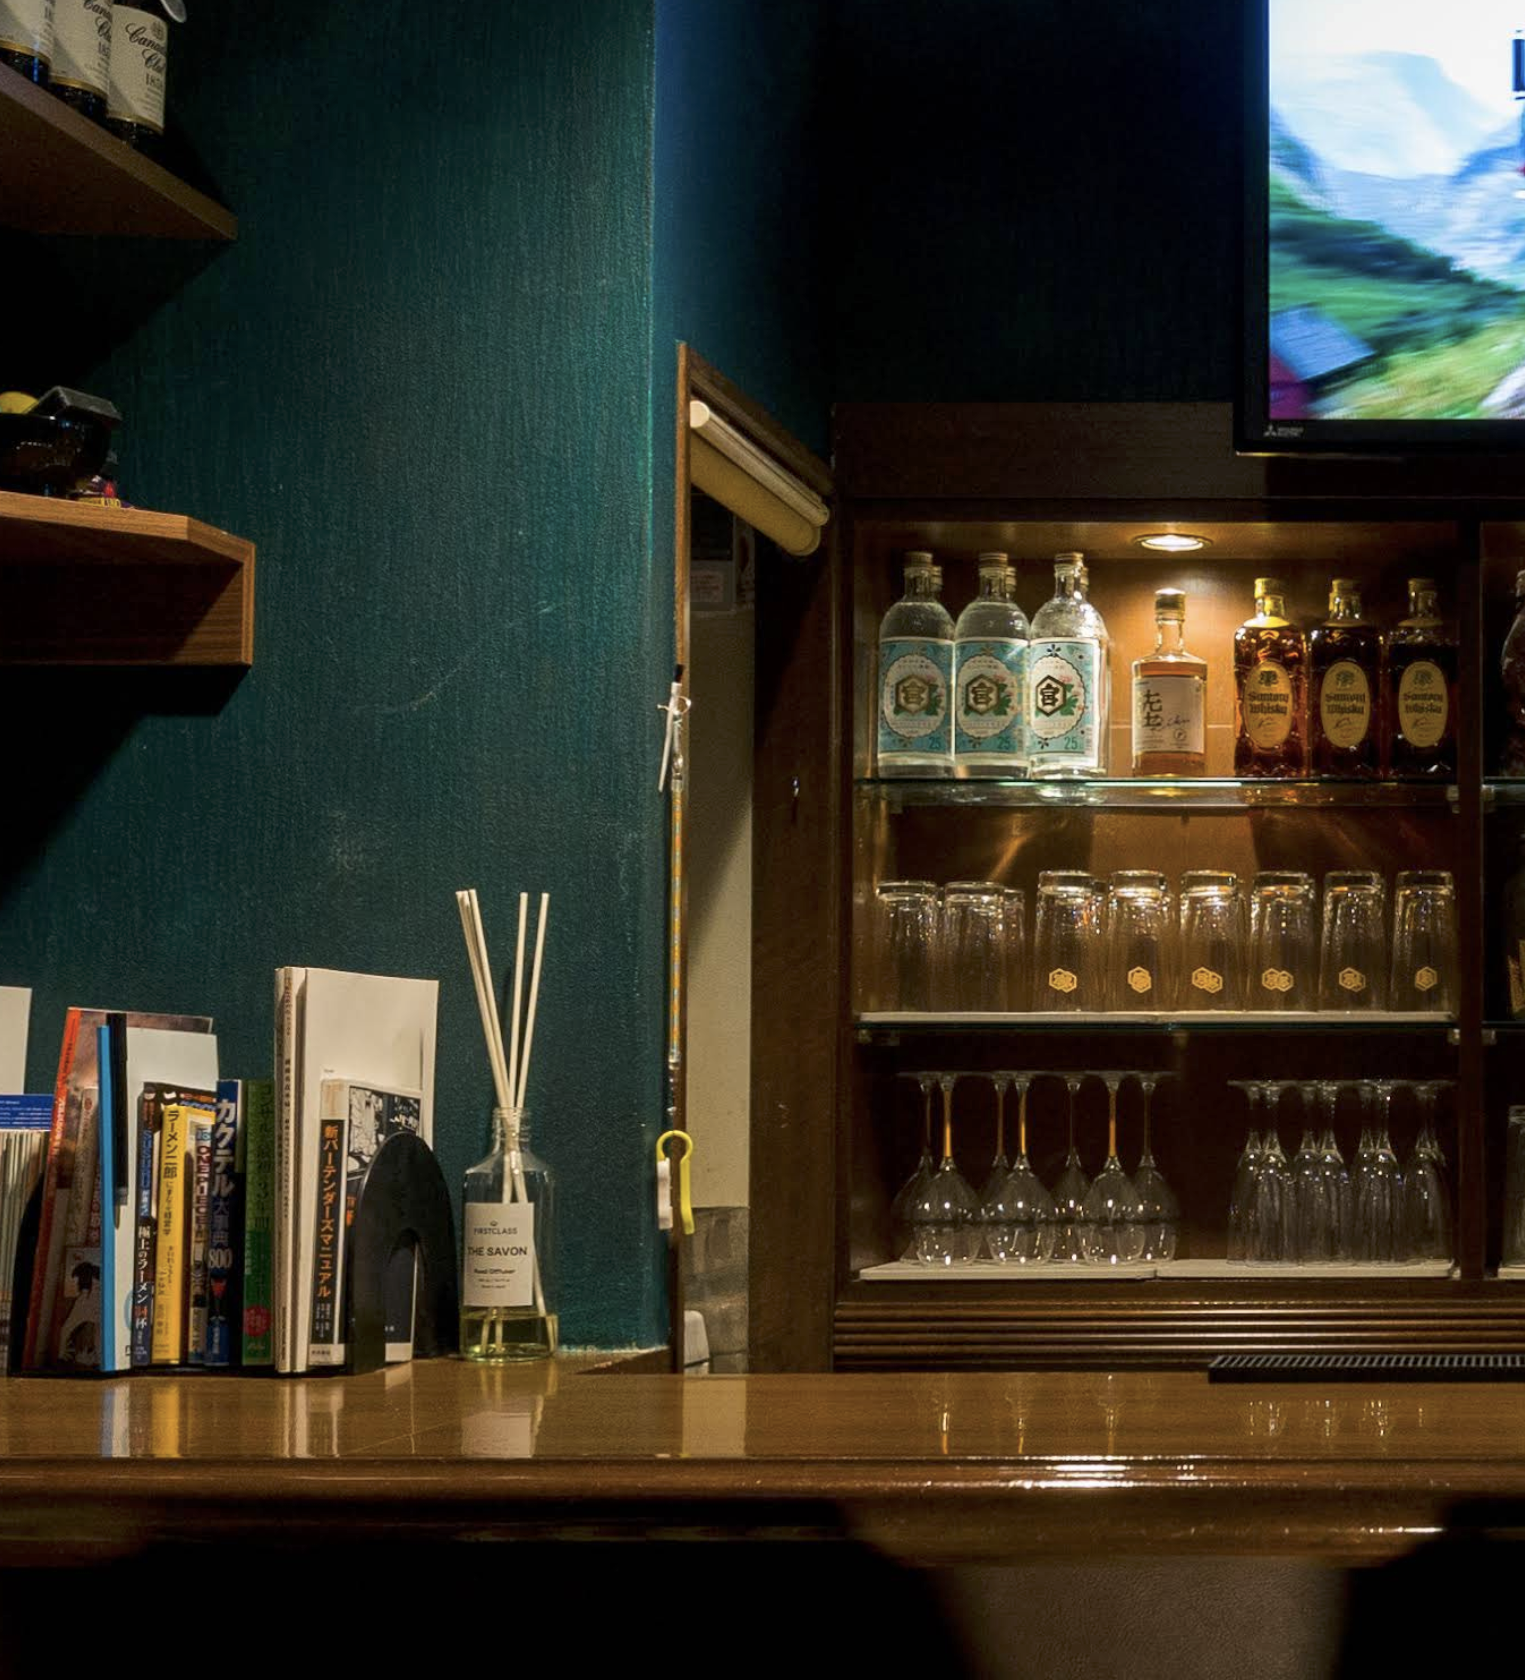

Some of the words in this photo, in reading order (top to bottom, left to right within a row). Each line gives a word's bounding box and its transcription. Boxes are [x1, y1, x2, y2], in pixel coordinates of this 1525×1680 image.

[1064, 736, 1079, 750] 25
[317, 1125, 341, 1298] 新バーテンダーズマニュアル
[473, 1226, 518, 1236] FIRSTCLASS
[467, 1246, 485, 1257] THE
[486, 1246, 528, 1257] SAVON
